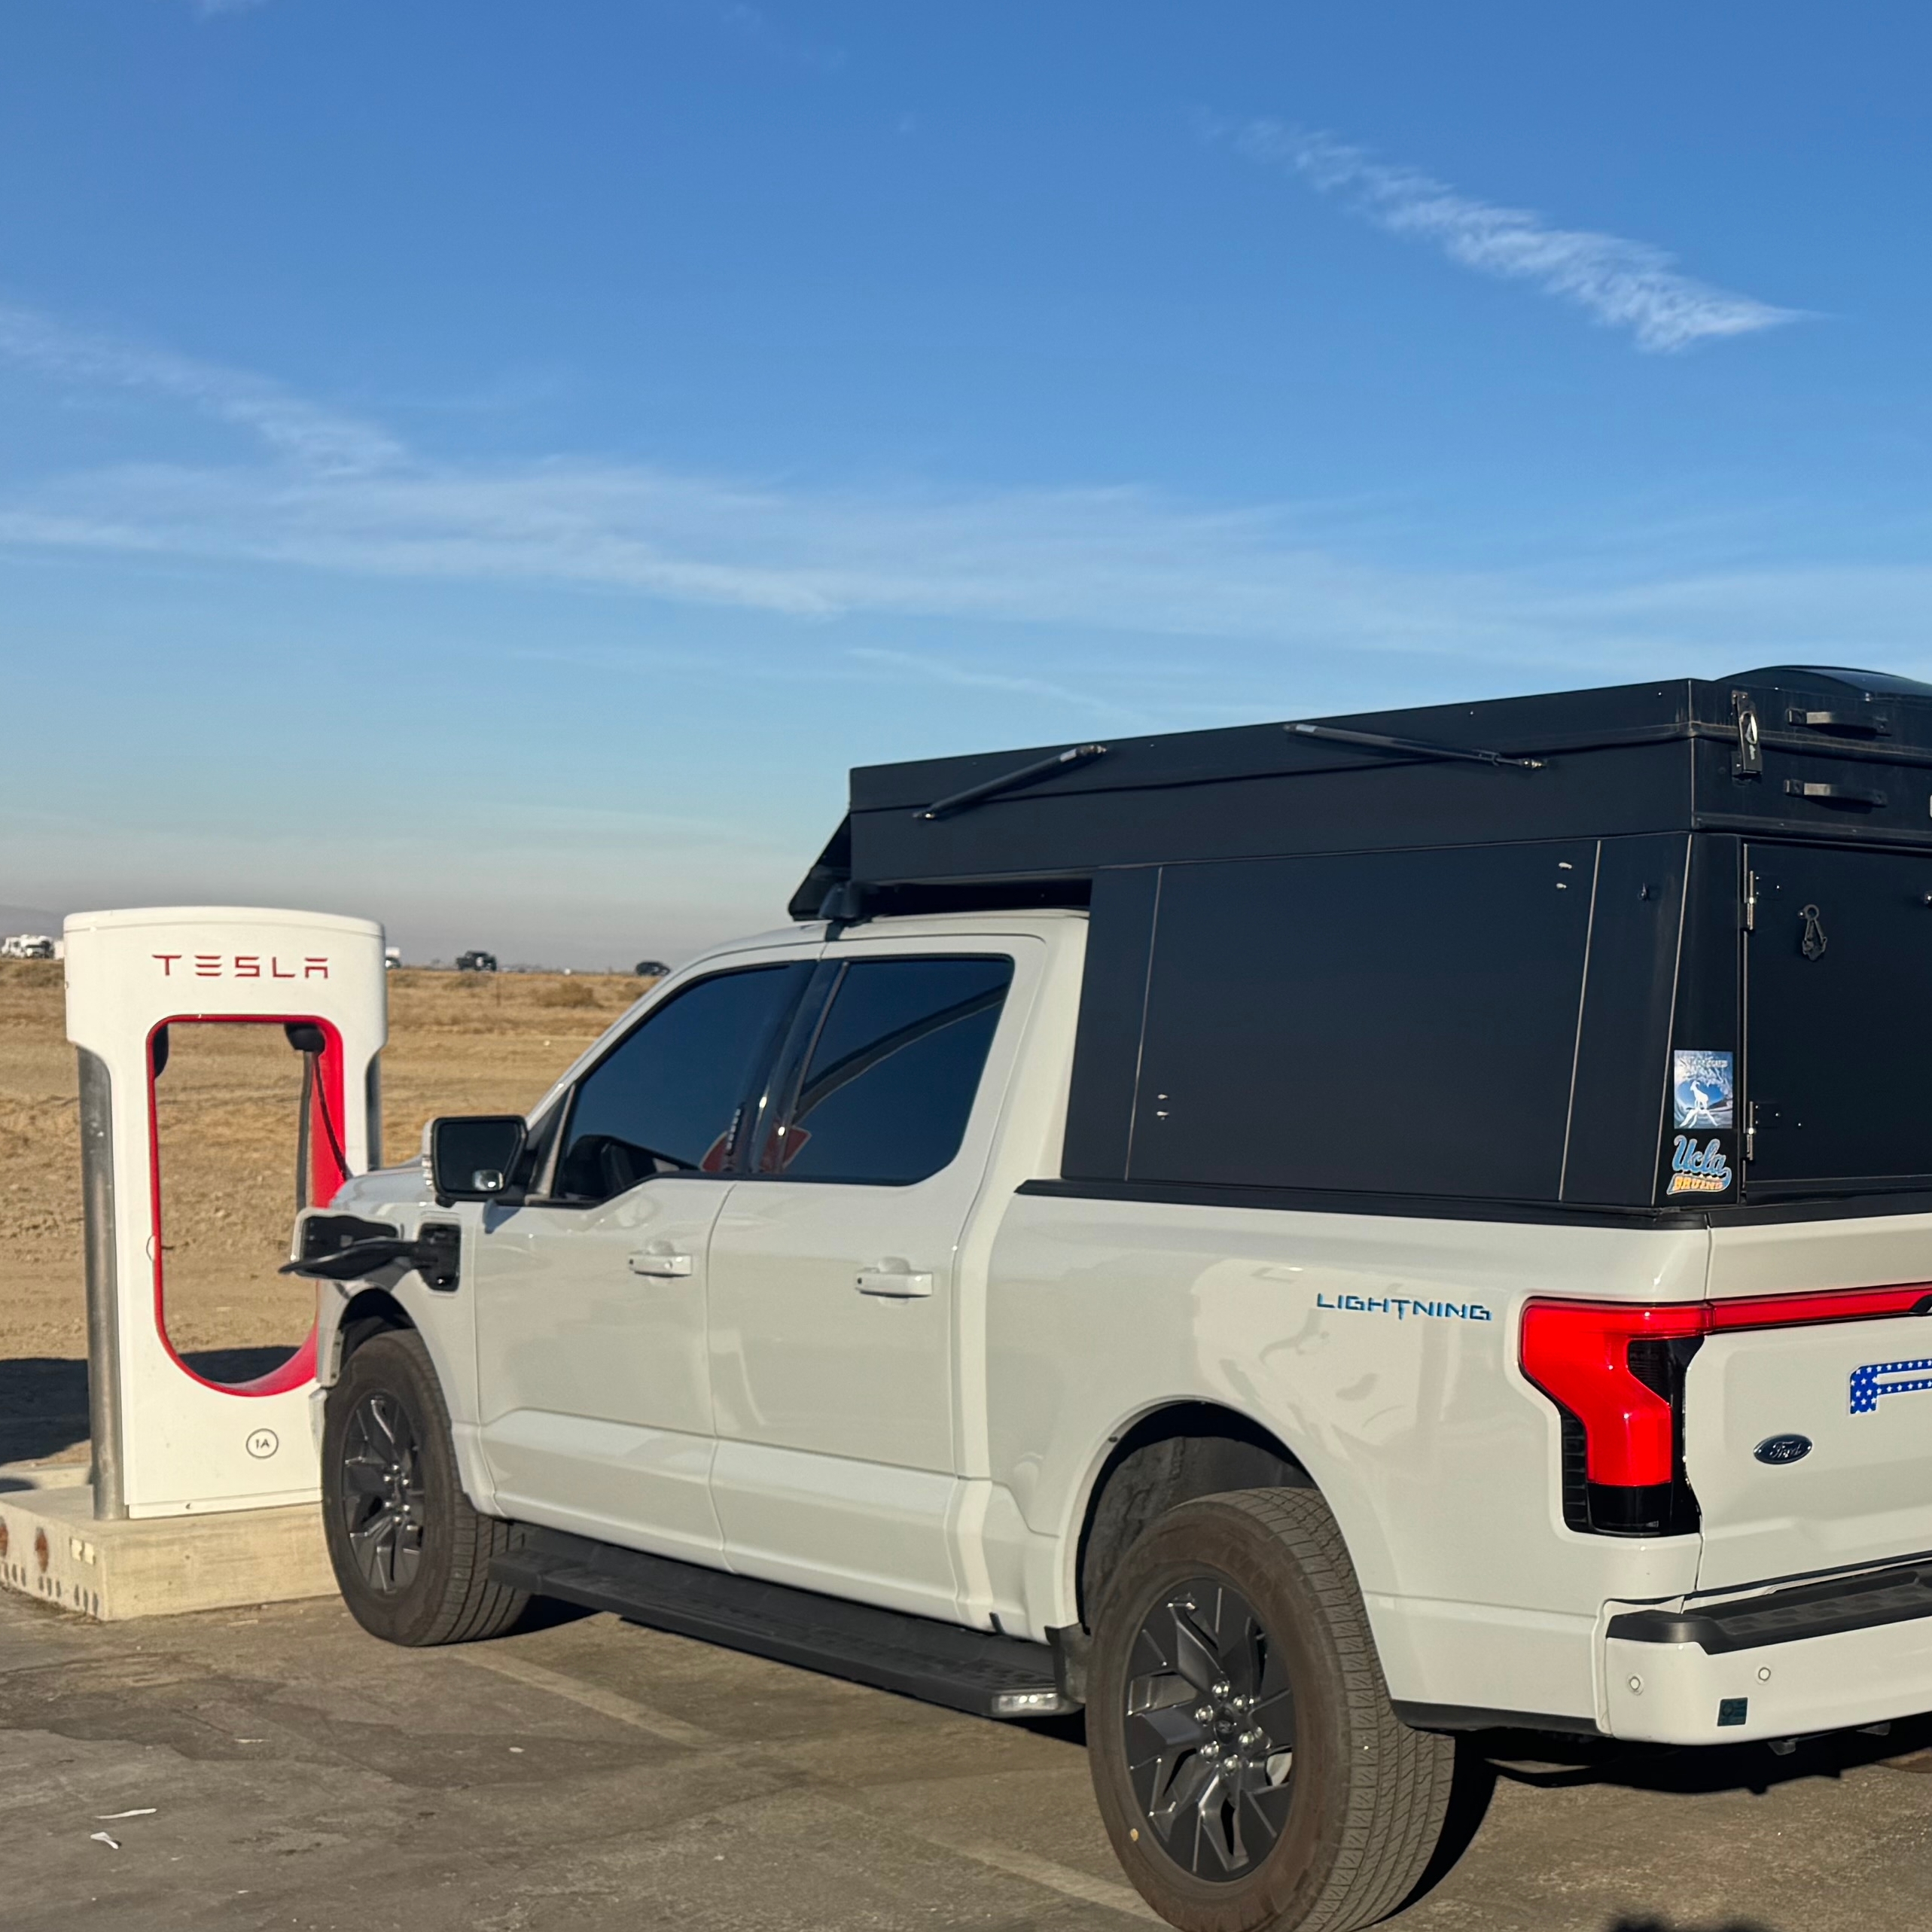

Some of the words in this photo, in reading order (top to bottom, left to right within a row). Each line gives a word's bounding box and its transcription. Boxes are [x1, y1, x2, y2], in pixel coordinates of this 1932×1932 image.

[151, 954, 328, 979] TESLA
[1317, 1293, 1492, 1321] LIGHTNING
[255, 1439, 270, 1449] 1A
[1769, 1441, 1802, 1458] Ford
